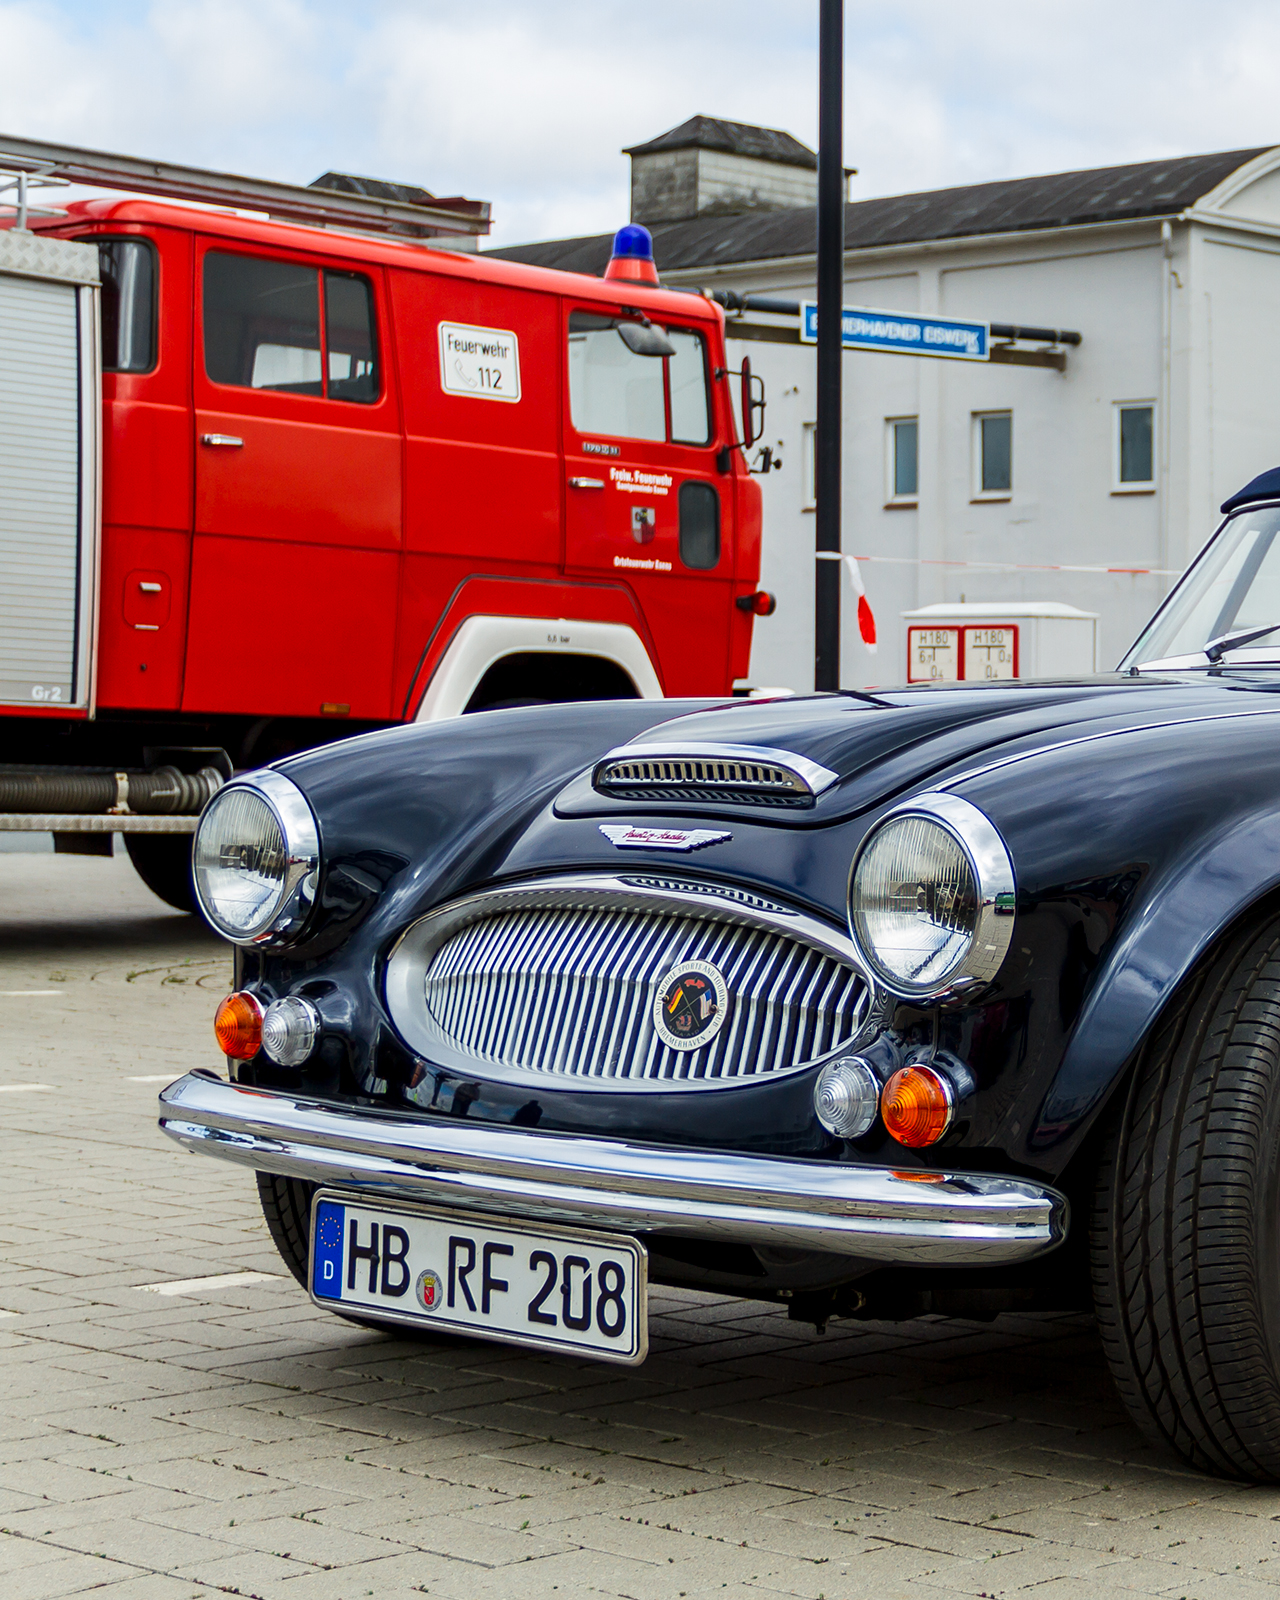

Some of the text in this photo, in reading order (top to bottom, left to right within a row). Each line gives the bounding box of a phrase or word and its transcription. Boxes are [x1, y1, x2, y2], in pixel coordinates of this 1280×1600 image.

[448, 333, 510, 358] Feuerwehr
[478, 367, 503, 390] 112
[634, 470, 673, 487] Feuerwehr
[32, 685, 62, 702] Gr2
[656, 970, 677, 1016] AUTOMOBILE
[678, 962, 702, 973] SPORTS
[703, 965, 716, 978] AND
[713, 1008, 725, 1028] CLUB
[659, 1026, 707, 1048] BREMERHAVEN
[323, 1259, 334, 1281] D
[347, 1218, 411, 1297] HB
[447, 1235, 515, 1314] RF
[527, 1249, 627, 1338] 208
